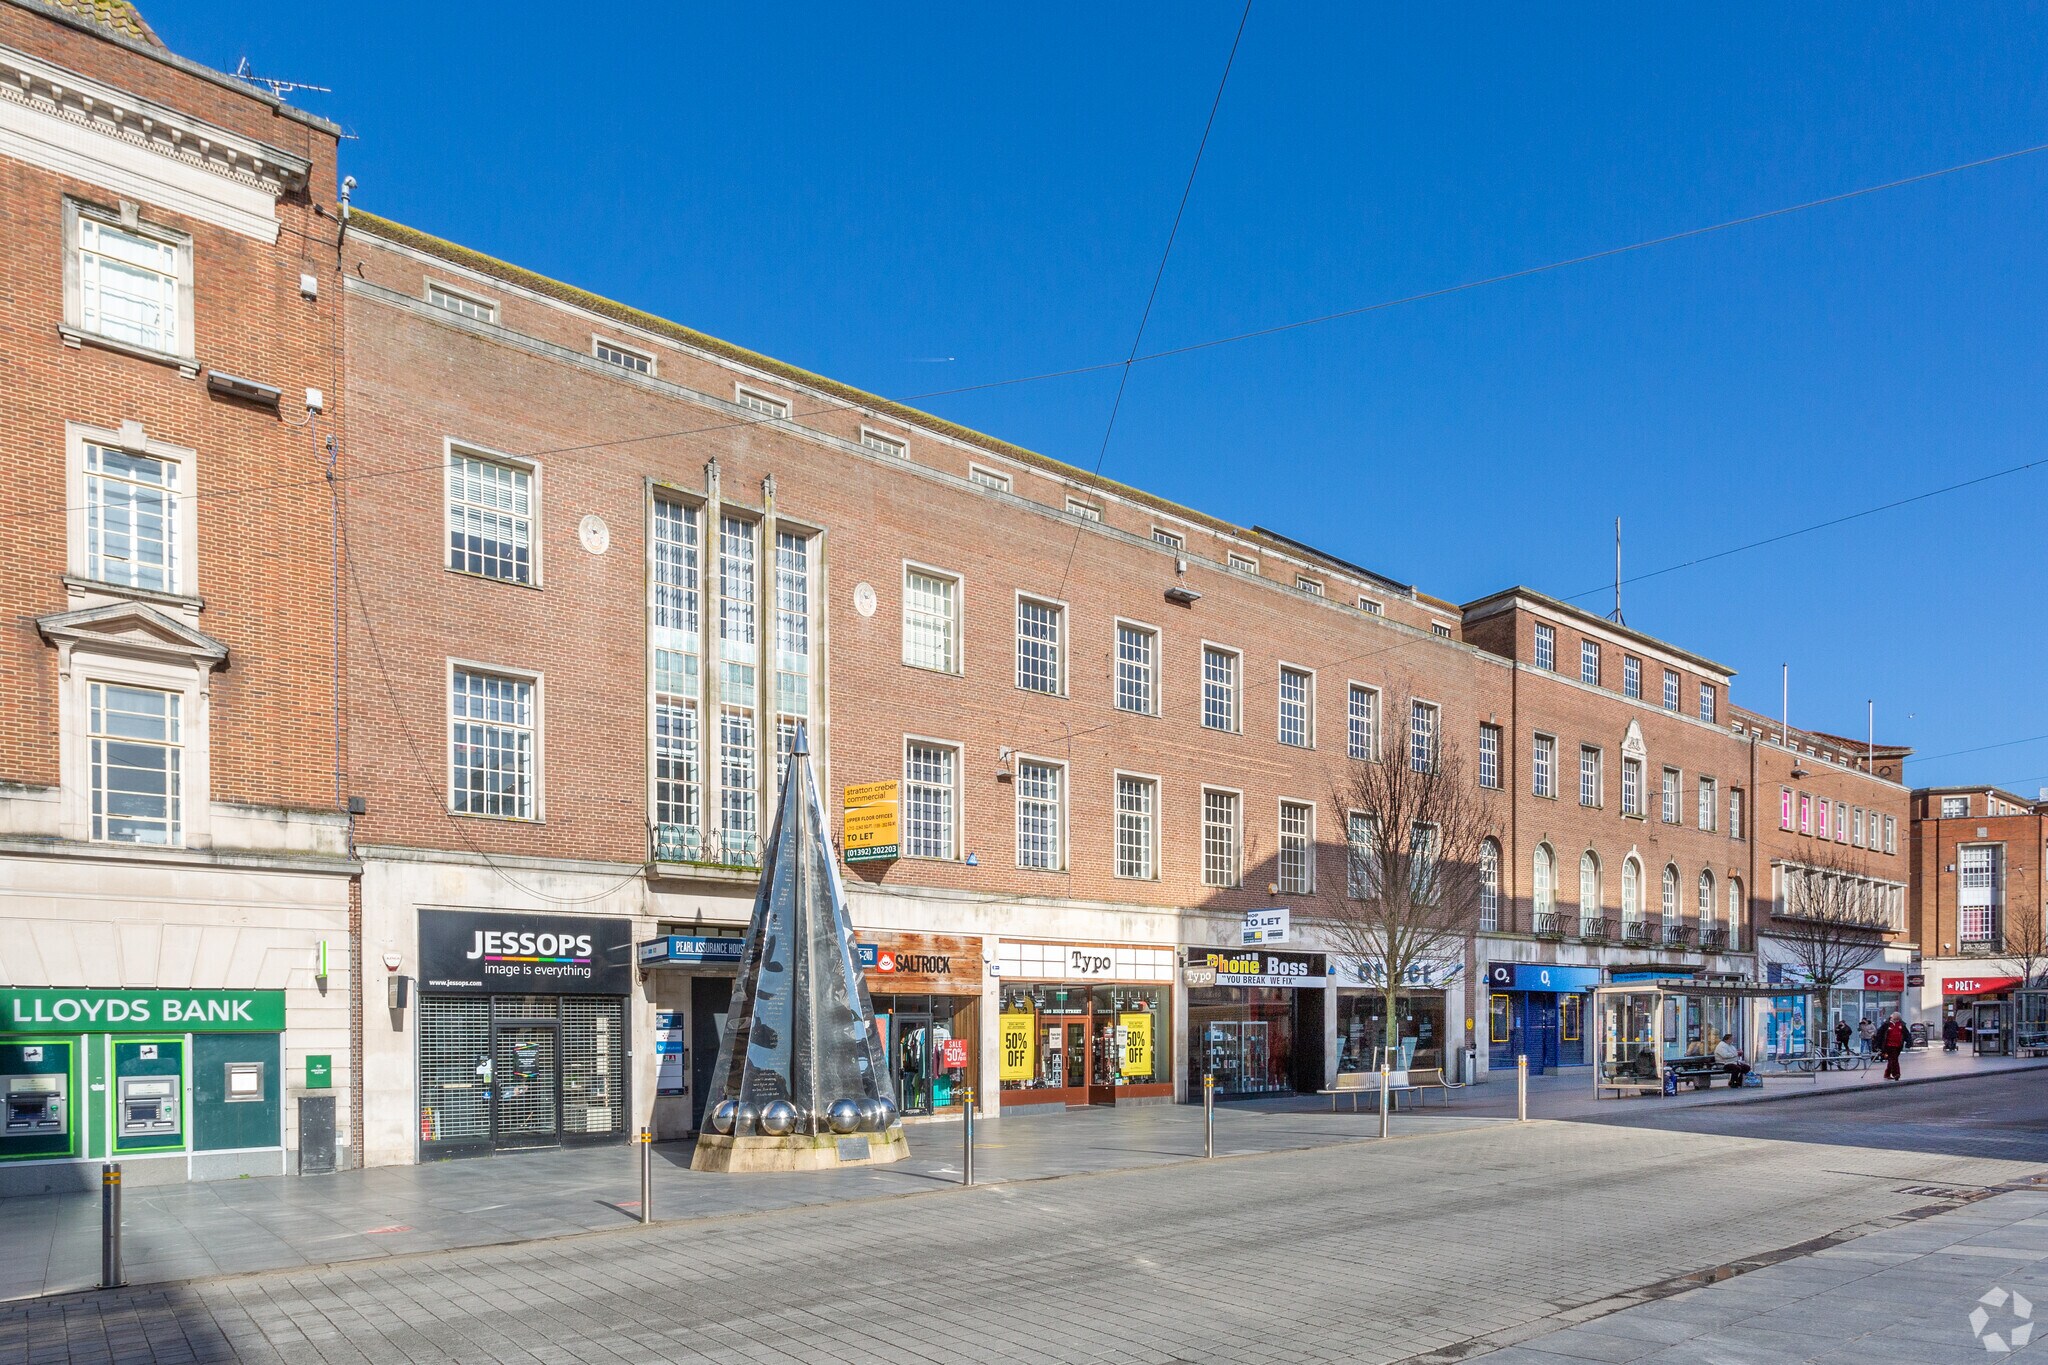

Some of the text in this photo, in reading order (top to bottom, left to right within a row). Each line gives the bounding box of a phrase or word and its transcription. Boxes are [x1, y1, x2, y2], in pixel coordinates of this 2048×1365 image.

[846, 783, 897, 796] stratton creber
[846, 792, 886, 803] commercial
[847, 845, 896, 857] (01392) 202203
[1245, 917, 1280, 927] TO LET
[466, 930, 592, 959] JESSOPS
[676, 941, 746, 954] PEARL ASSURANCE HOUS
[896, 954, 951, 973] SALTROCK
[1072, 951, 1111, 973] Typo
[1207, 954, 1308, 975] Phone Boss
[485, 963, 591, 978] image is everything
[1187, 971, 1212, 982] Typo
[1358, 962, 1432, 984] OFCE
[1243, 976, 1265, 984] BREAK
[1270, 976, 1280, 984] WE
[1955, 980, 1974, 991] PRET
[13, 999, 253, 1022] LLOYDS BANK
[1006, 1032, 1027, 1049] 50%
[1127, 1031, 1145, 1046] 50%
[947, 1048, 962, 1061] 50%
[1008, 1050, 1024, 1067] OFF
[1129, 1048, 1143, 1063] OFF
